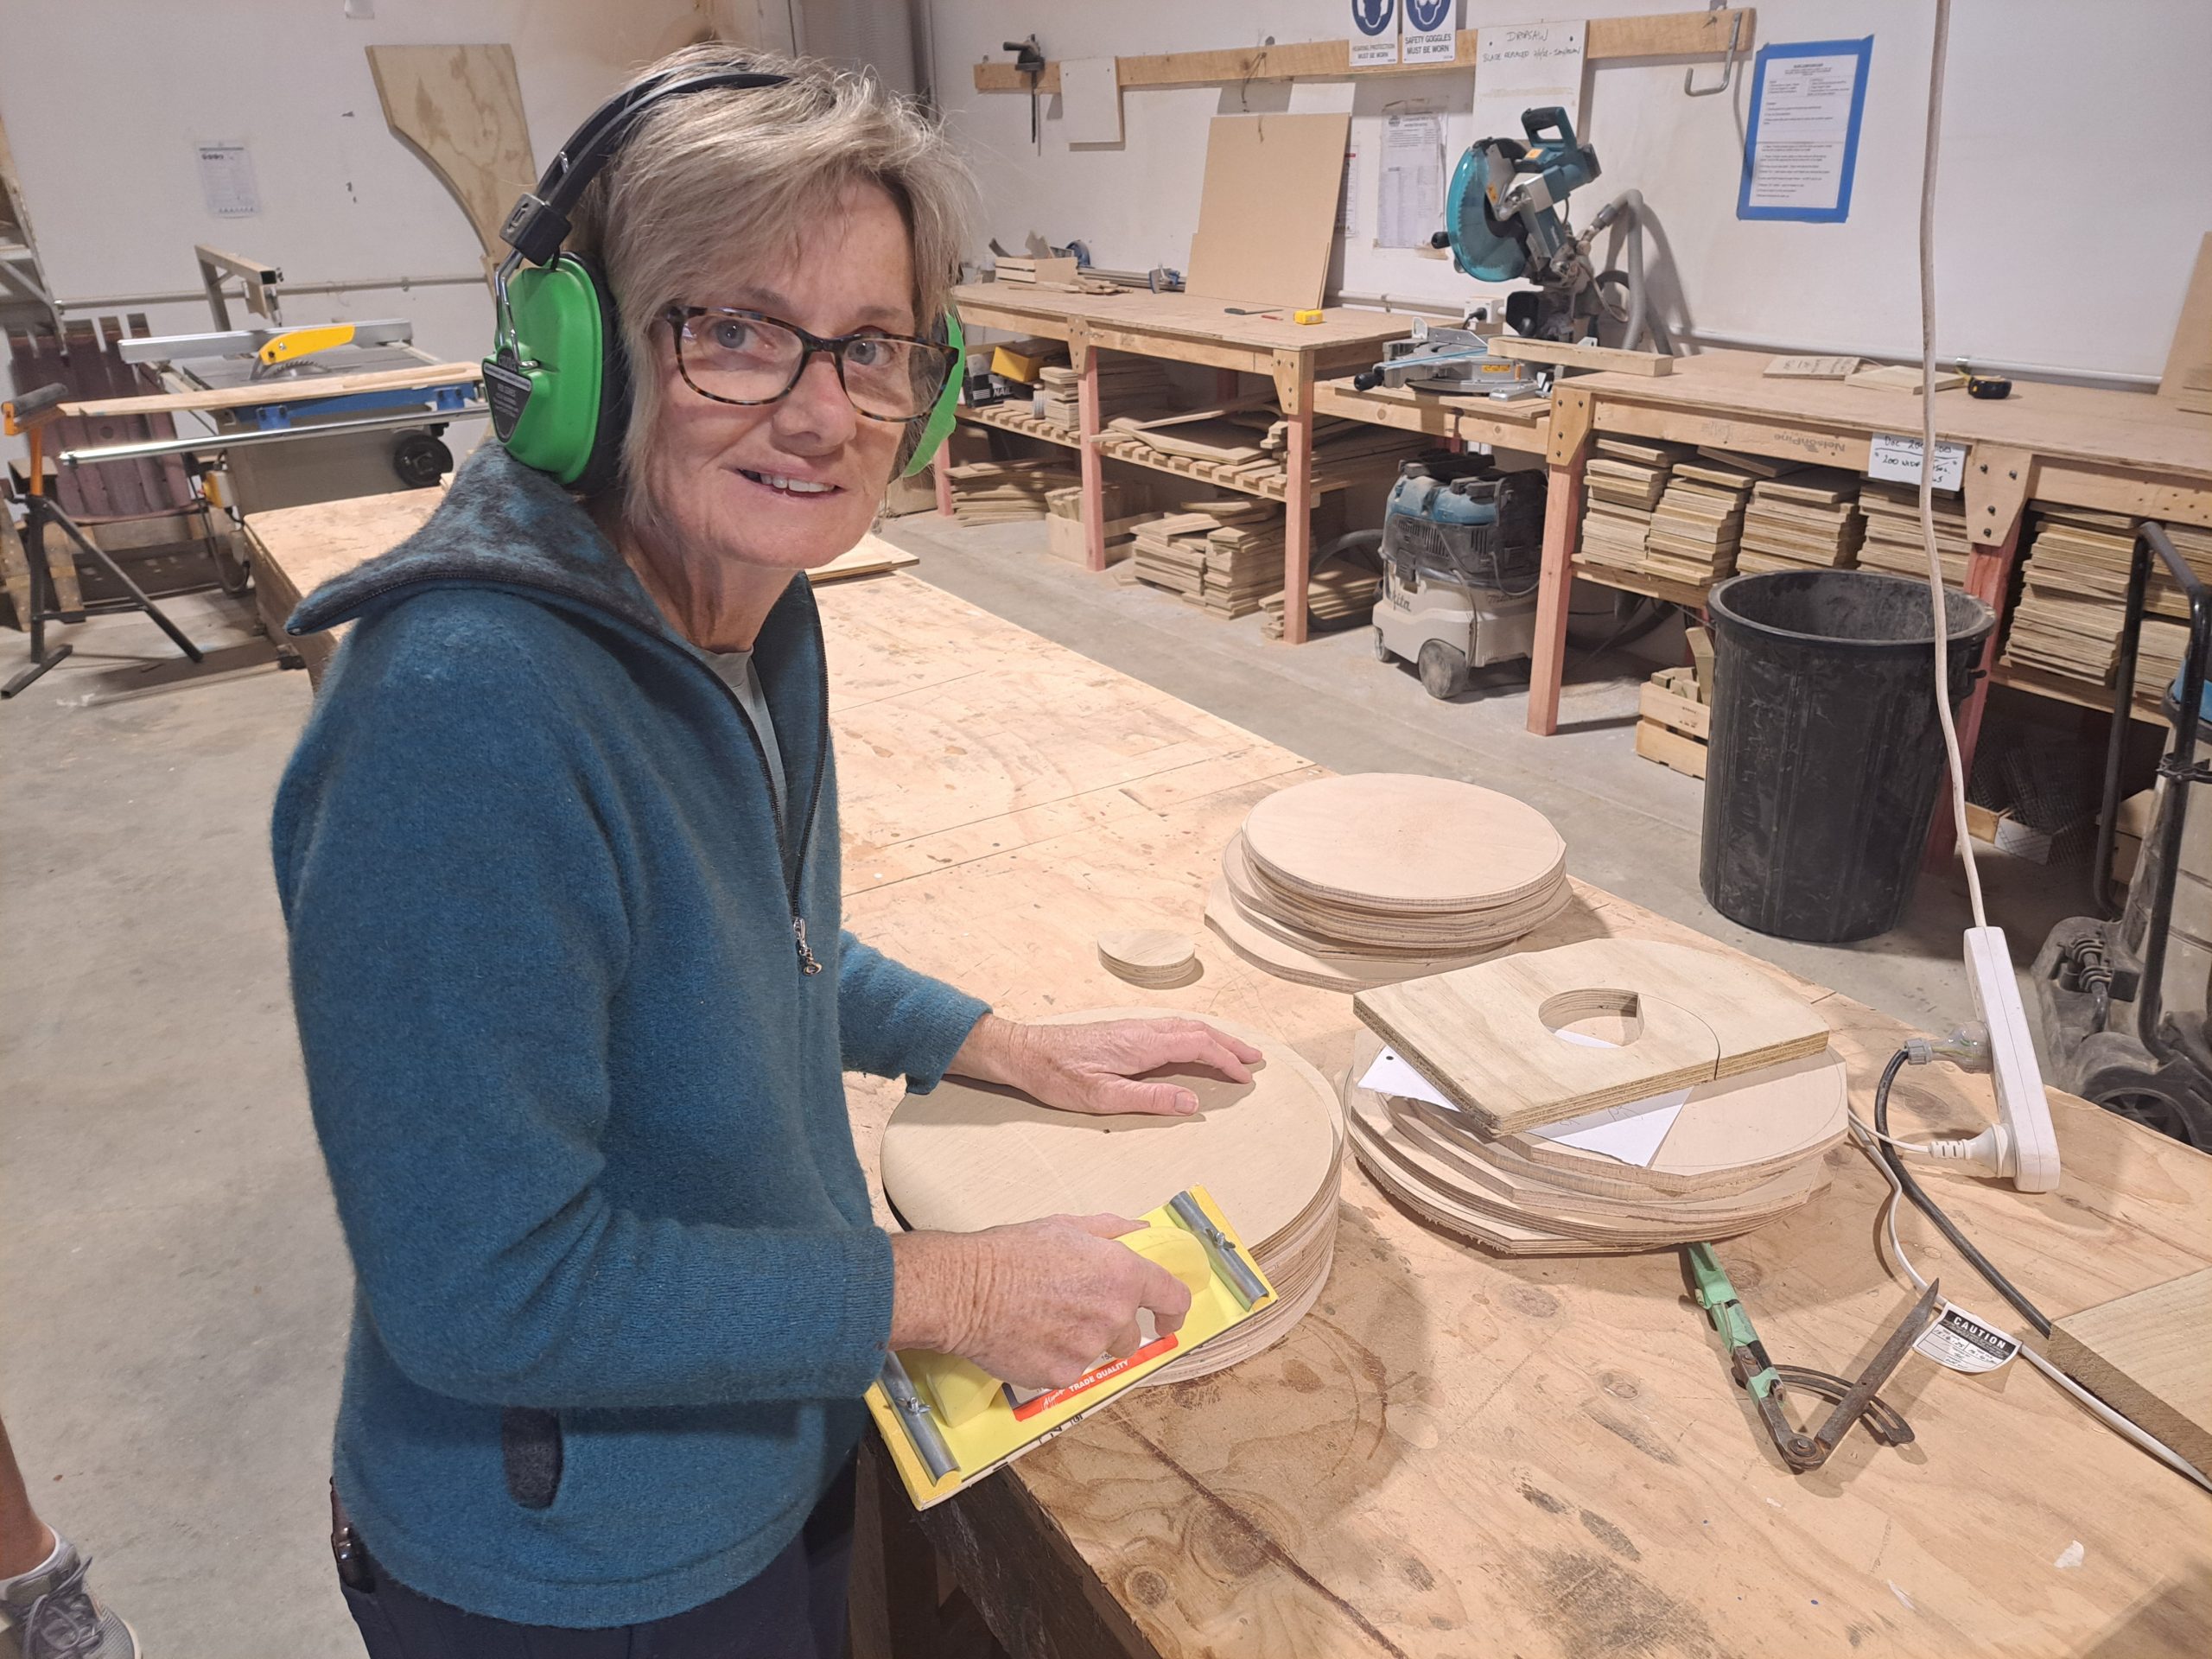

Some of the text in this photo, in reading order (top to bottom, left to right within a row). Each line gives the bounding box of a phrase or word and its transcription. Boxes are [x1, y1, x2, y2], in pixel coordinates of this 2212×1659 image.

[1425, 34, 1452, 42] GOGGLES
[1953, 1316, 2006, 1350] CAUTION
[1068, 1375, 1096, 1393] TRADE
[1096, 1359, 1129, 1380] QUALITY
